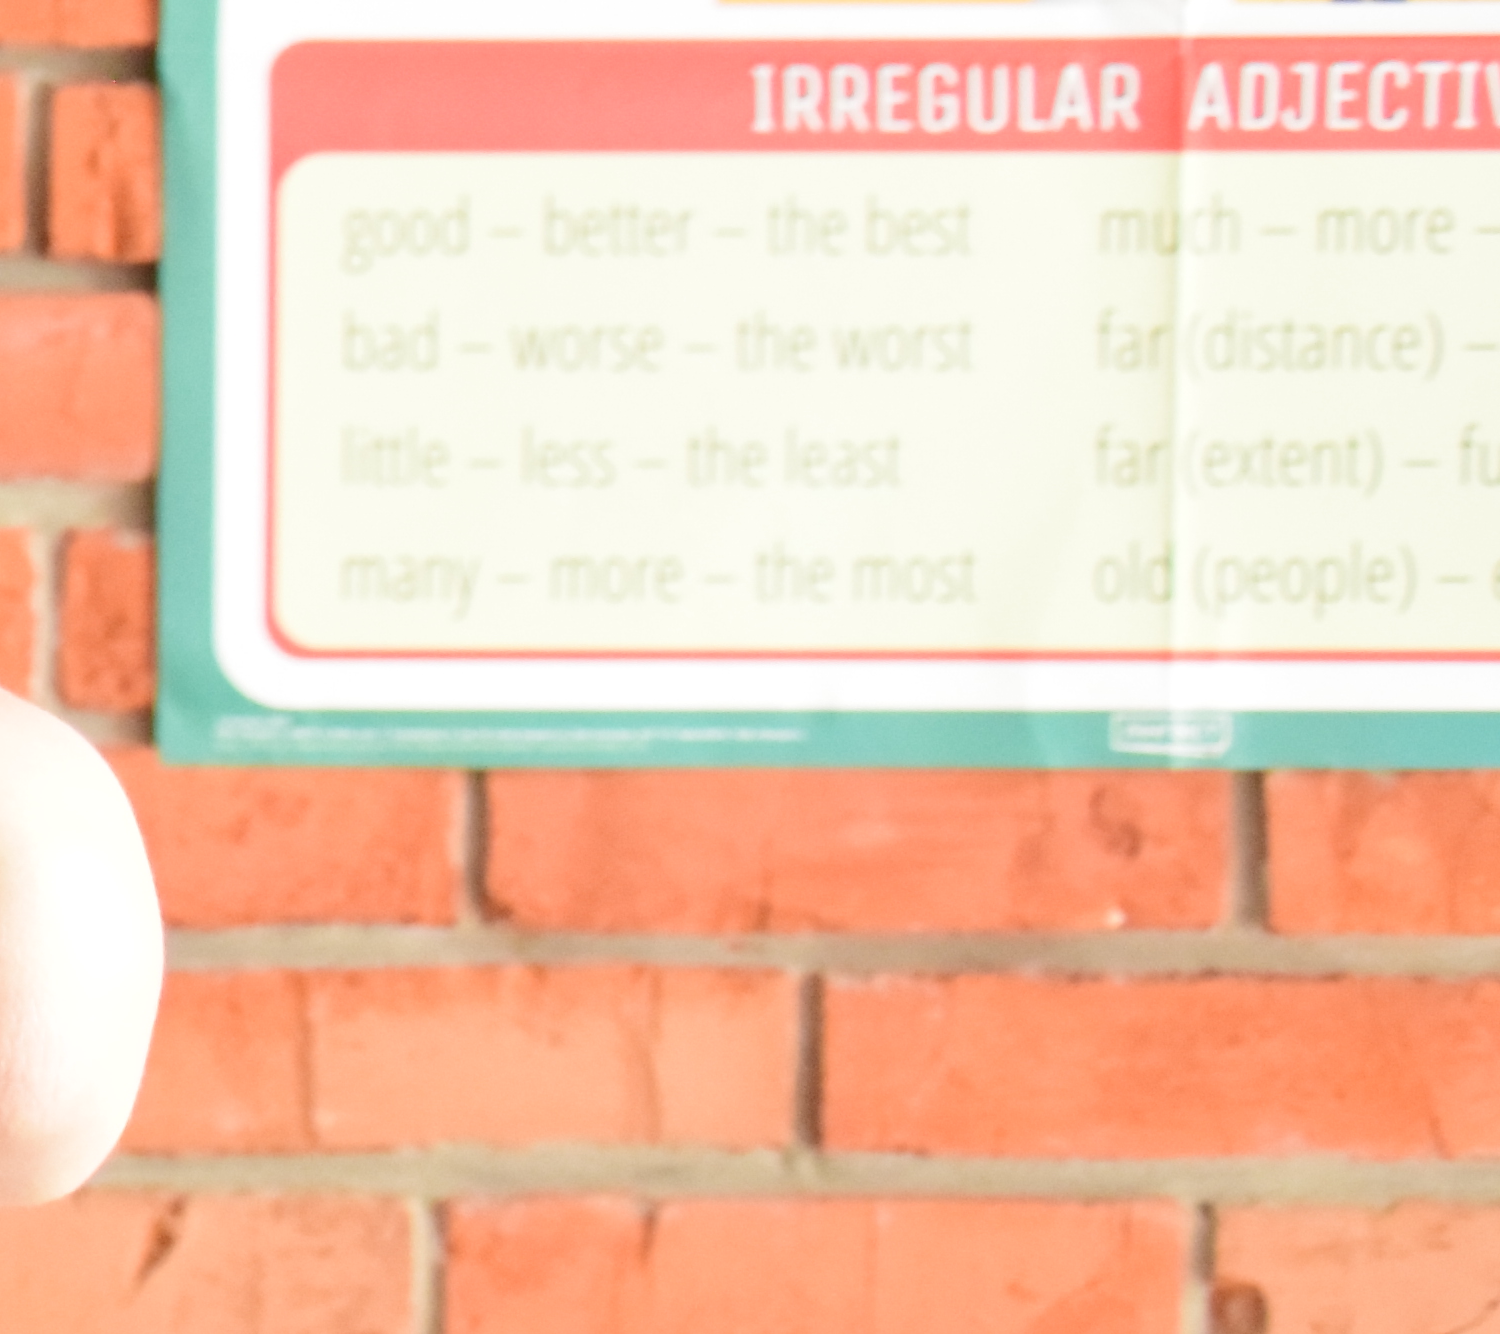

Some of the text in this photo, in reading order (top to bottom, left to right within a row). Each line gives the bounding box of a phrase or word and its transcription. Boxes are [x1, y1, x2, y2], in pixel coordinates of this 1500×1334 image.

[748, 62, 1143, 134] IRREGULAR
[341, 196, 972, 273] good better the best
[1098, 194, 1457, 256] much more
[341, 310, 973, 373] bad worse the worst
[1097, 309, 1446, 380] far (distance)
[340, 424, 901, 487] little less the least
[1097, 425, 1166, 488] far
[1185, 428, 1385, 497] (extent)
[340, 543, 976, 621] many more the most
[1091, 543, 1172, 604] old
[1193, 540, 1418, 619] (people)
